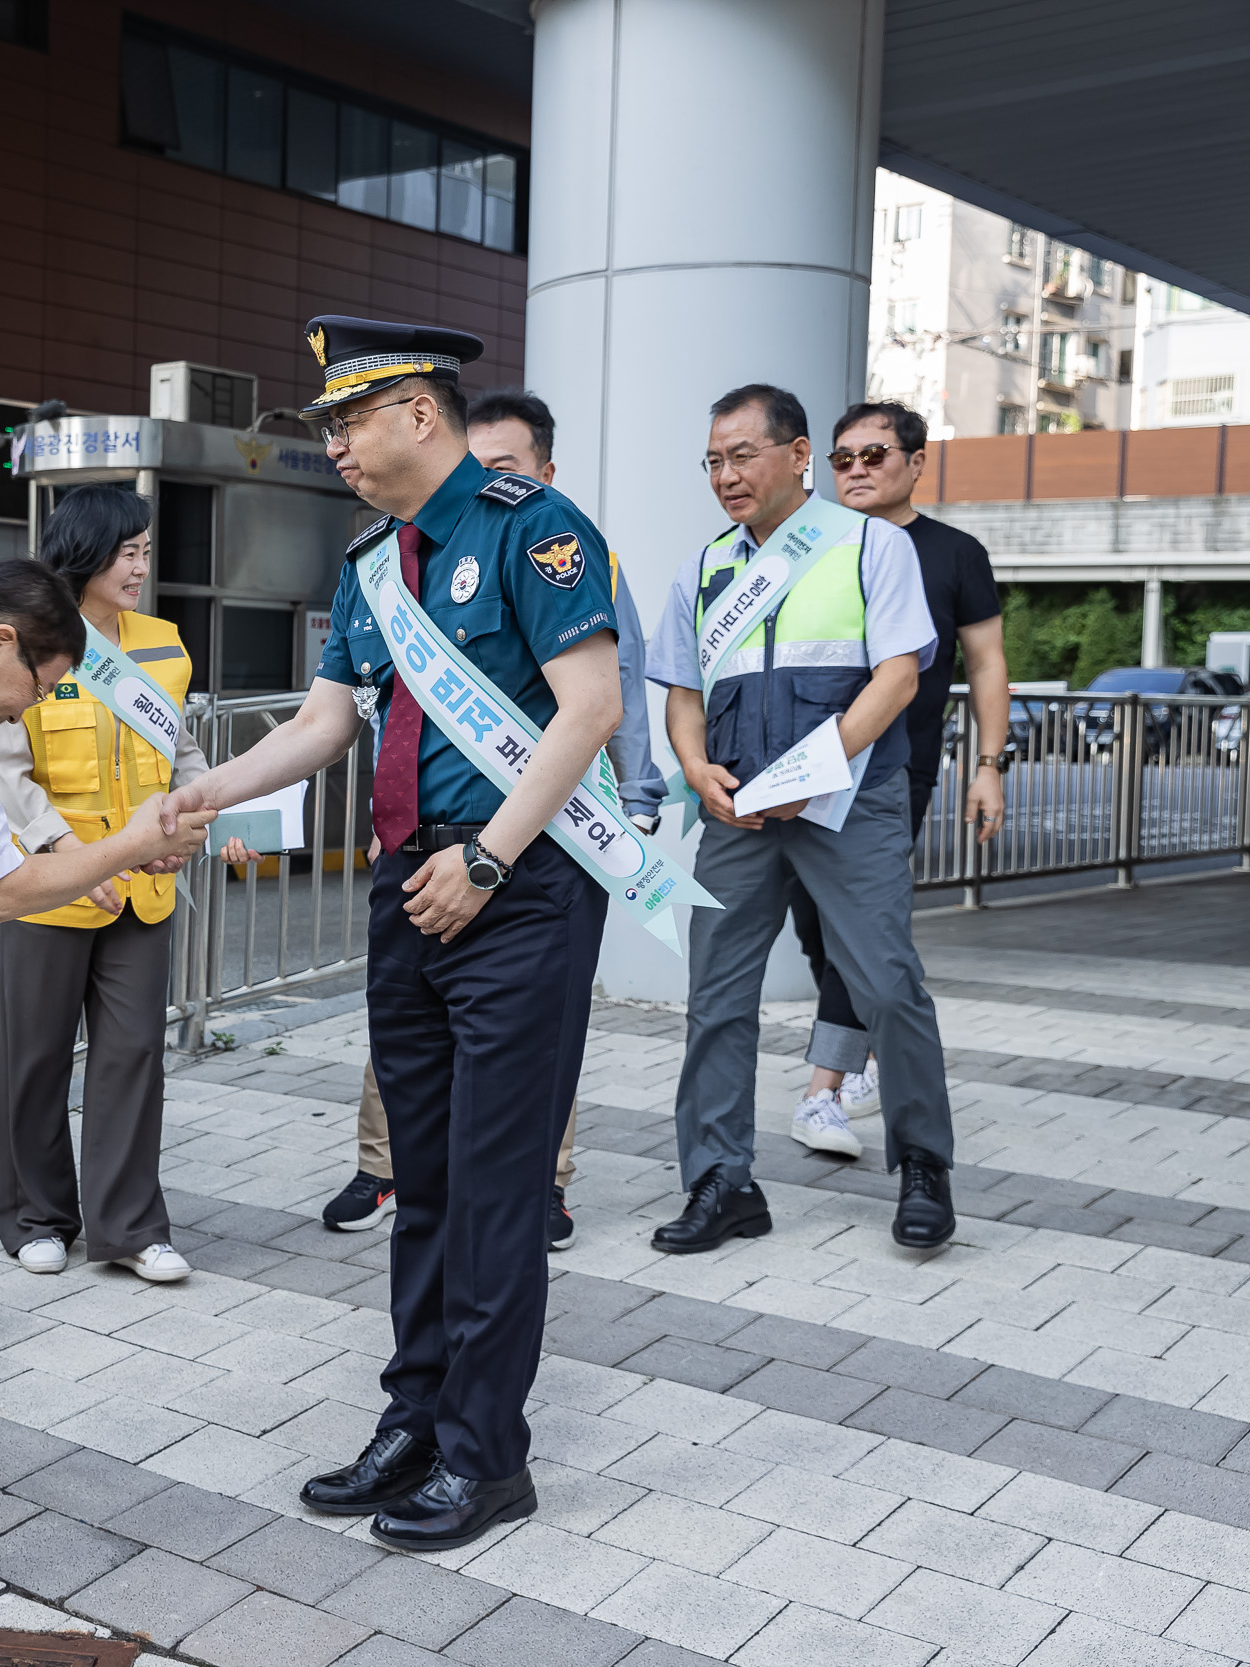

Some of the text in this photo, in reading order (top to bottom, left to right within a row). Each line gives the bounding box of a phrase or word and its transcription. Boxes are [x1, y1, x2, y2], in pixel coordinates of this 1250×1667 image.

[555, 567, 578, 580] POLICE
[706, 575, 771, 650] 횡단보도
[91, 656, 115, 682] 아이먼저
[102, 666, 121, 686] 캠페인
[390, 603, 436, 675] 아이
[429, 668, 503, 743] 먼저
[133, 693, 177, 748] 횡단보
[635, 858, 664, 889] 행정안전부
